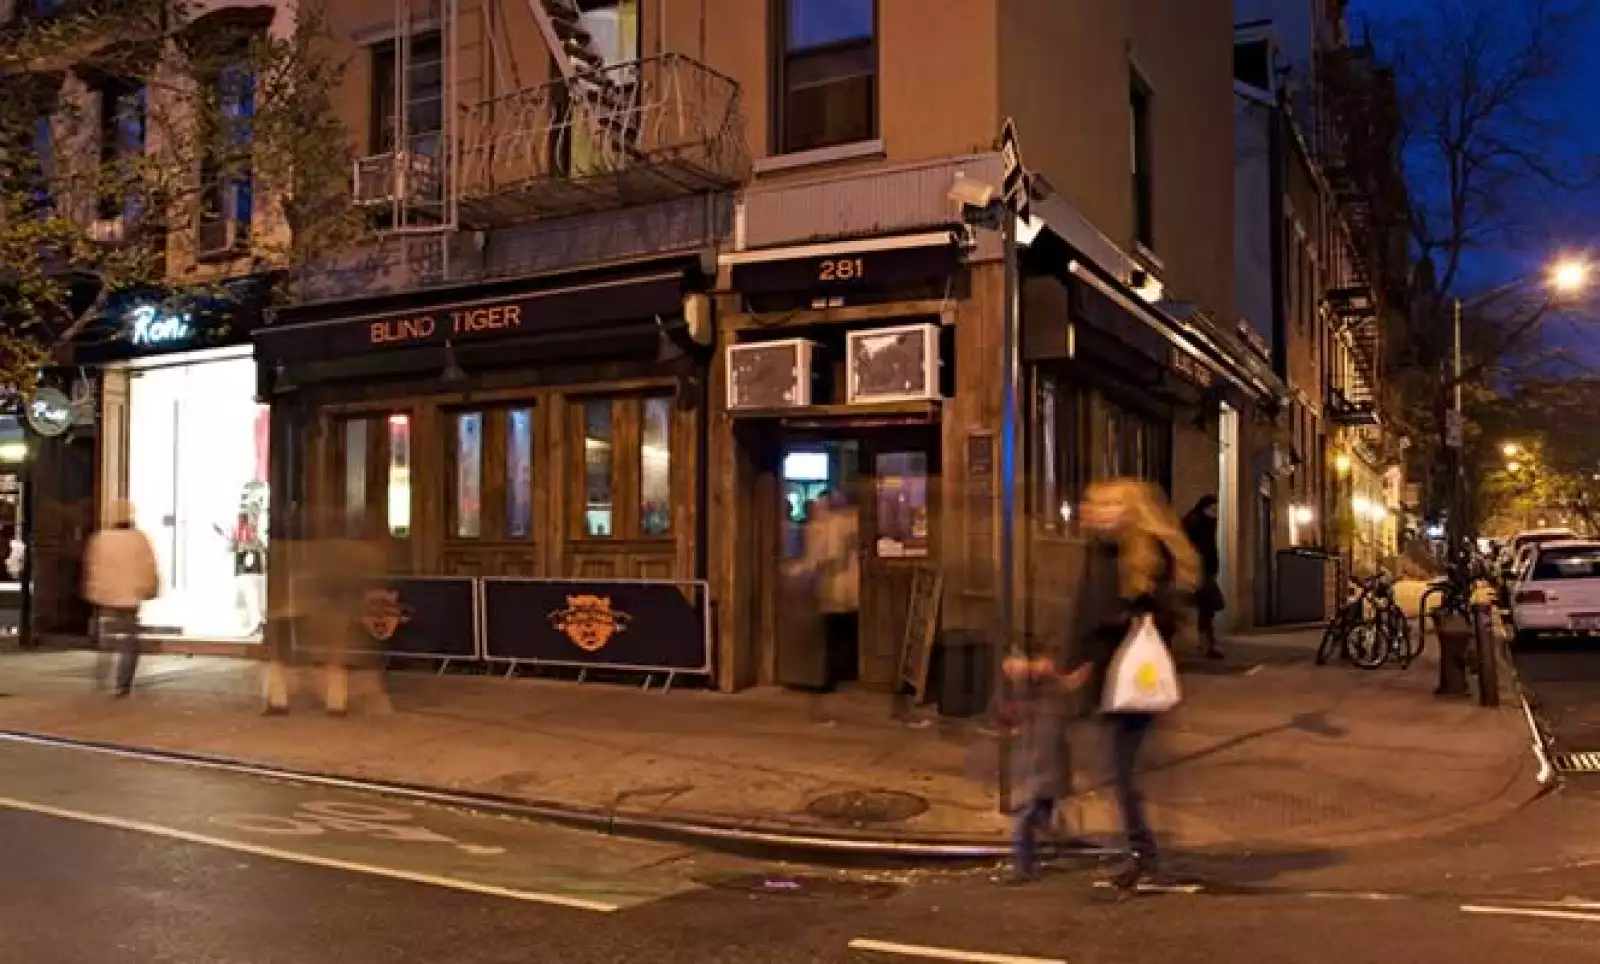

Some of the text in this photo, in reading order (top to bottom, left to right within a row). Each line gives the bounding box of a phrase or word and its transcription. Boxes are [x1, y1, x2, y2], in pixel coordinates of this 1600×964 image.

[819, 258, 863, 280] 281
[370, 305, 520, 342] BLIND TIGER
